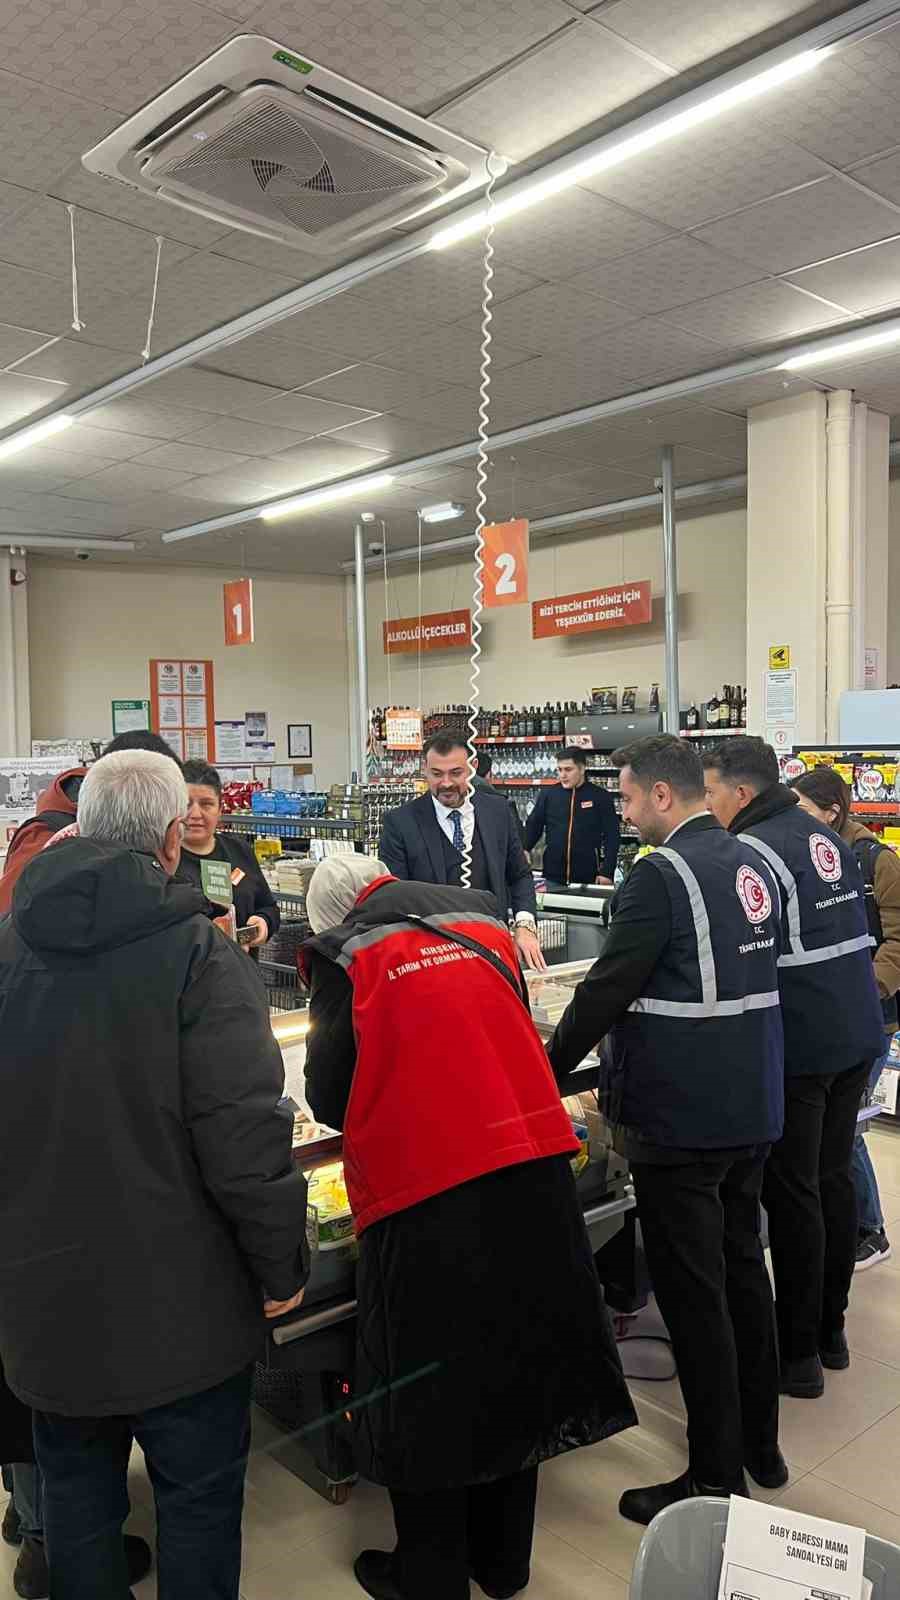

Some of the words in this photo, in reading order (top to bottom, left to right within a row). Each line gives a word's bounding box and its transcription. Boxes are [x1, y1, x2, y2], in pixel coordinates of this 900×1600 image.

[495, 553, 517, 596] 2
[539, 604, 554, 617] BİZİ
[554, 599, 583, 614] TERCİH
[582, 592, 623, 610] ETTİĞİNİZ
[623, 588, 641, 604] İÇİN
[232, 603, 243, 635] 1
[554, 612, 594, 629] TEŞEKKÜR
[595, 606, 626, 621] EDERİZ.
[387, 626, 421, 642] ALKOLLÜ
[421, 623, 466, 641] İÇECEKLER
[753, 925, 765, 934] T.C.
[387, 968, 397, 981] İL
[396, 960, 422, 978] TARIM
[422, 958, 433, 968] VE
[433, 951, 462, 966] ORMAN
[769, 1524, 790, 1540] BABY
[824, 1539, 849, 1556] MAMA
[786, 1545, 833, 1568] SANDALYESİ
[834, 1558, 849, 1572] GRİ
